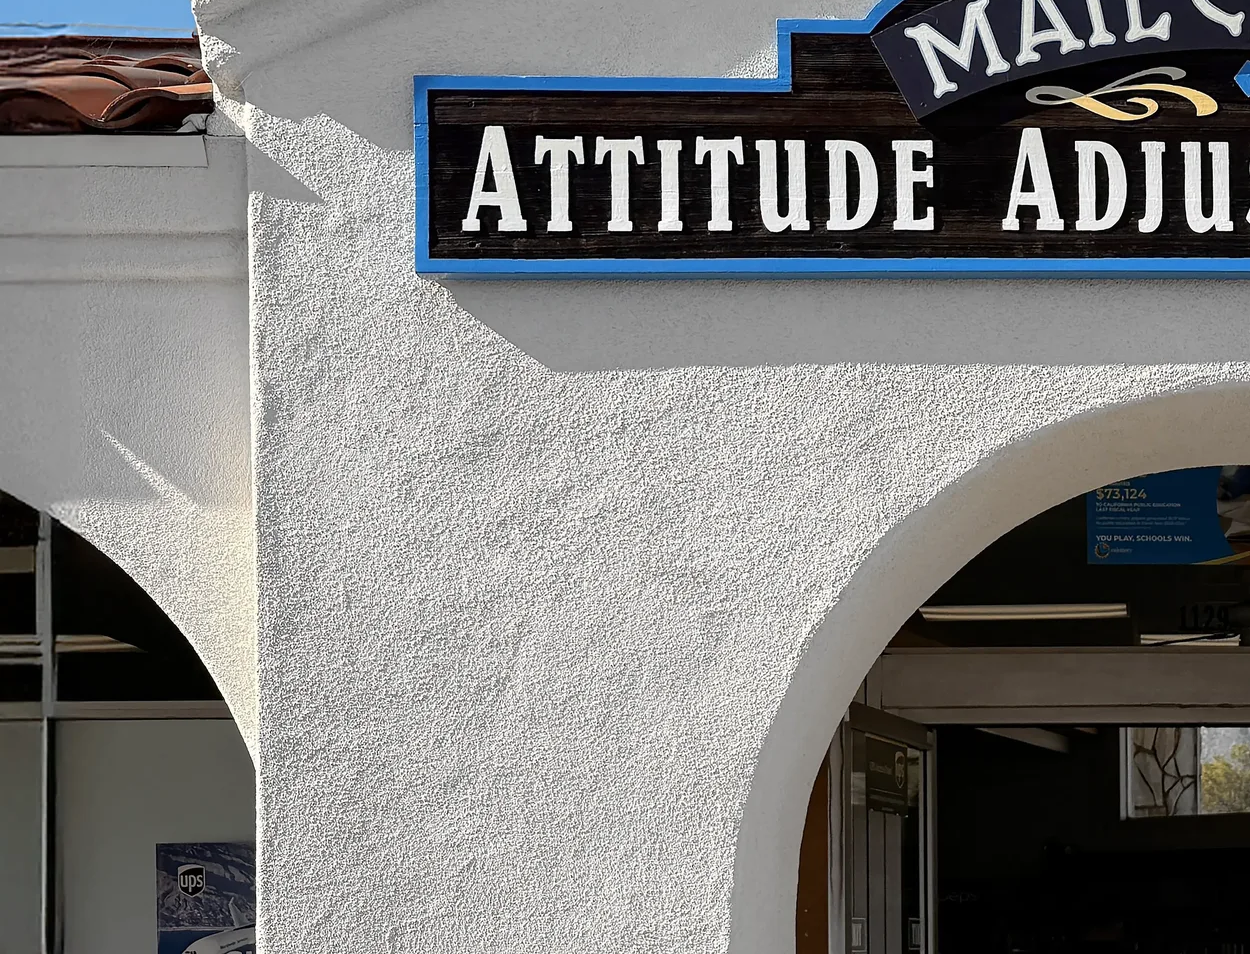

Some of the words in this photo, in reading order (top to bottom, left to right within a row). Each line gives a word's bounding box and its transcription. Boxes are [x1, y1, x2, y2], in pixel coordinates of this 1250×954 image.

[461, 125, 935, 233] ATTITUDE
[1096, 488, 1147, 500] $73,124
[1180, 605, 1229, 631] 1129
[180, 874, 204, 893] ups
